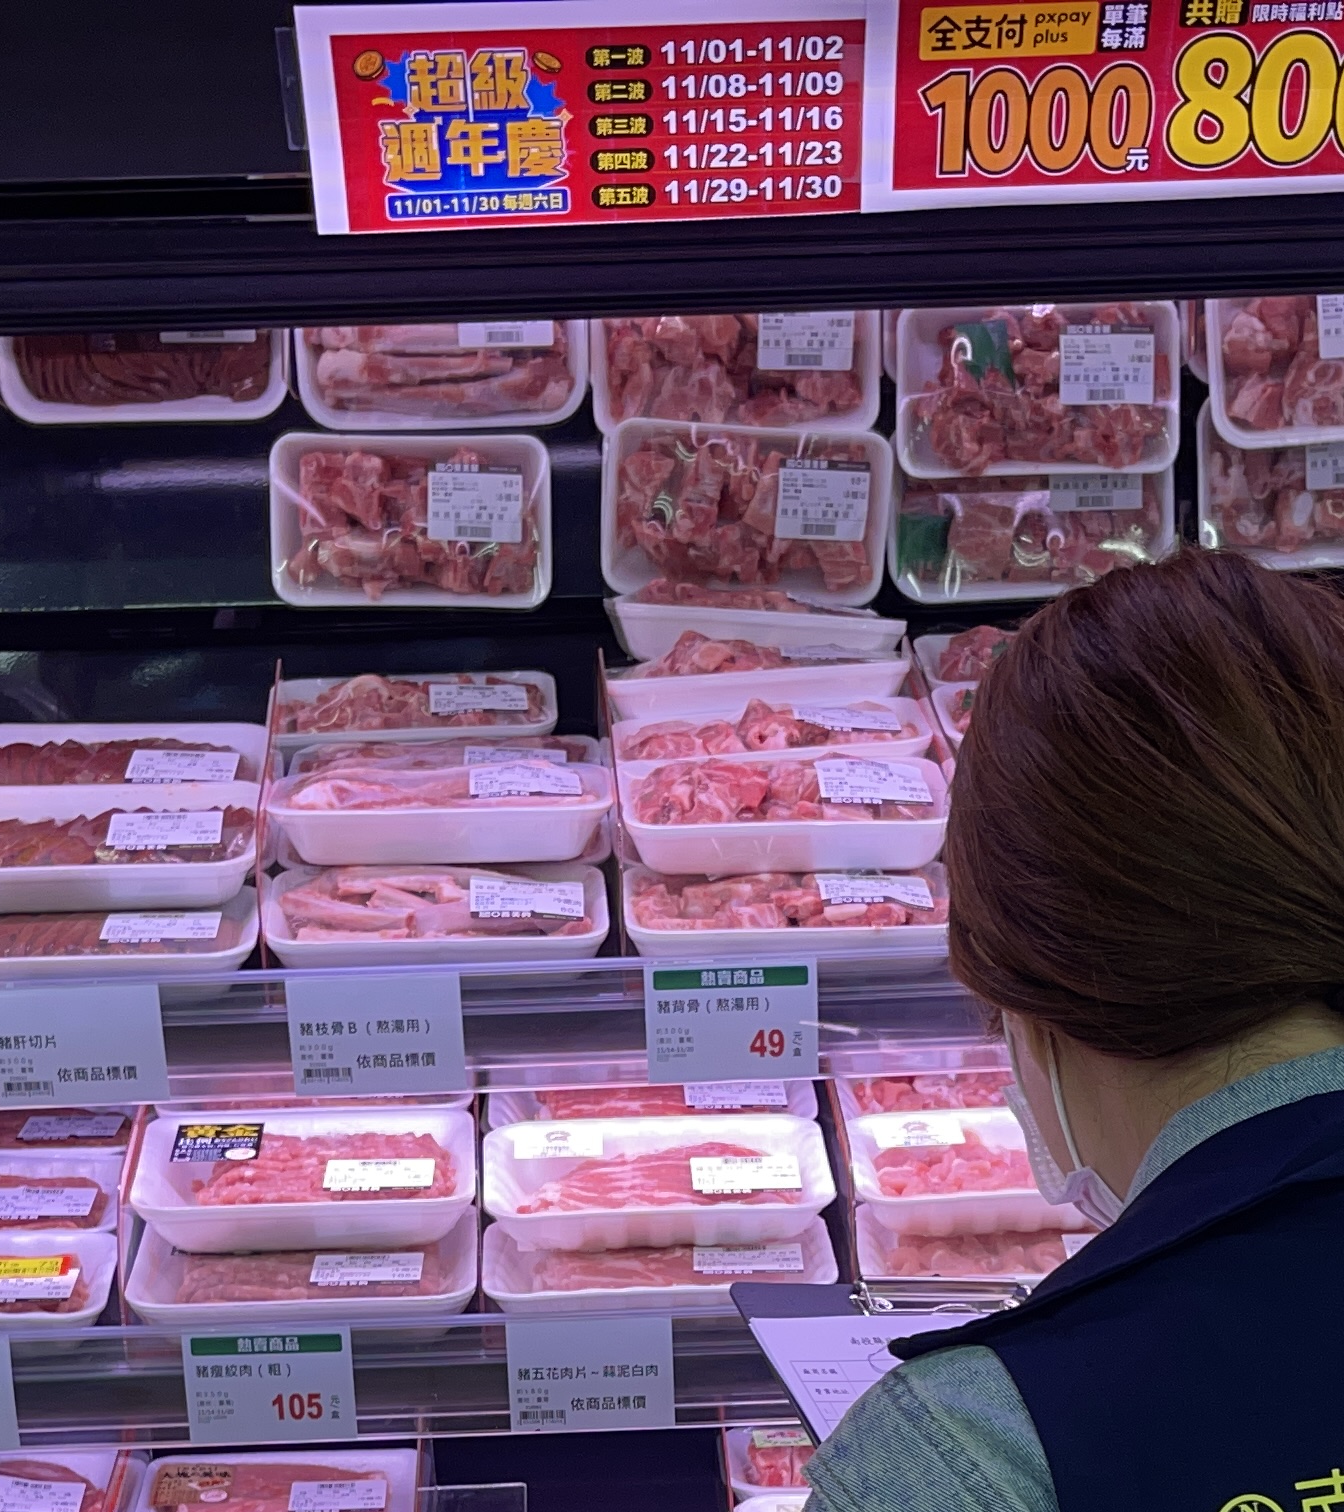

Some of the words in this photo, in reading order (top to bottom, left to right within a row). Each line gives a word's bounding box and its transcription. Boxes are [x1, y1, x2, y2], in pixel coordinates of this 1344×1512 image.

[1034, 11, 1090, 28] pxpay
[1102, 4, 1146, 26] 單筆
[1185, 0, 1240, 25] 共贈
[1252, 1, 1343, 22] 限時福利點
[928, 15, 1028, 50] 全支付
[1034, 28, 1068, 47] plus
[1101, 27, 1145, 49] 每滿
[592, 47, 646, 66] 第一波
[660, 37, 843, 65] 11/01-11/02
[406, 49, 529, 112] 超級
[594, 82, 646, 101] 第二波
[662, 72, 843, 100] 11/08-11/09
[596, 116, 647, 135] 第三波
[662, 107, 843, 135] 11/15-11/16
[920, 63, 1153, 176] 1000
[1126, 148, 1150, 171] 元
[382, 117, 565, 181] 週年慶
[597, 151, 648, 171] 第四波
[664, 142, 843, 169] 11/22-11/23
[394, 195, 499, 214] 11/01-11/30
[502, 193, 563, 212] 每週六日
[599, 186, 649, 206] 第五波
[665, 176, 841, 204] 11/29-11/30
[700, 969, 765, 986] 熱賣商品
[751, 1029, 785, 1058] 49
[356, 1051, 437, 1069] 依商品標價
[57, 1065, 138, 1083] 依商品標價
[237, 1336, 299, 1352] 熱賣商品
[518, 1367, 587, 1381] 豬五花肉片
[603, 1364, 658, 1379] 蒜泥白肉
[272, 1393, 323, 1420] 105
[571, 1395, 647, 1411] 依商品標價
